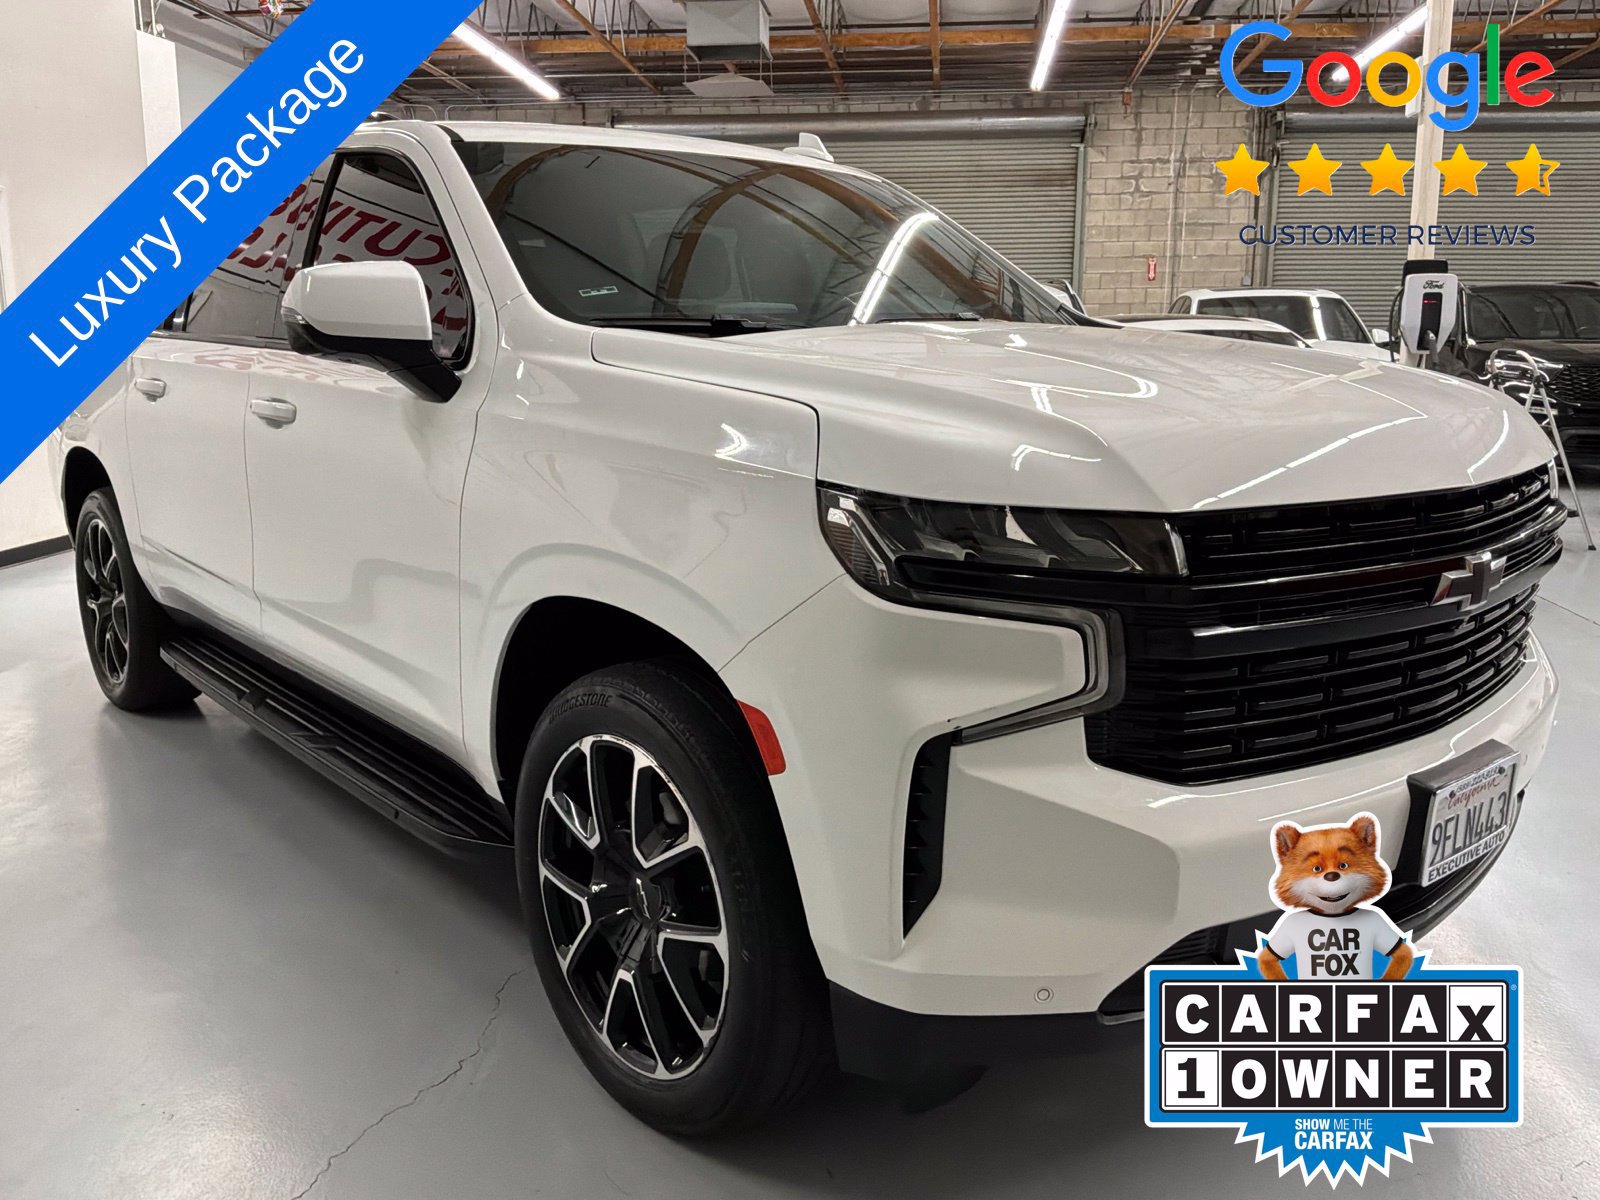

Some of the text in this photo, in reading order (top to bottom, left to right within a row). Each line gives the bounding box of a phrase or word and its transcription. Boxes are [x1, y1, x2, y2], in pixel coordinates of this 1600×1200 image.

[1423, 280, 1444, 289] Ford
[1429, 791, 1507, 868] 9FLN443
[1428, 831, 1504, 882] EXECUTIVE AUTO
